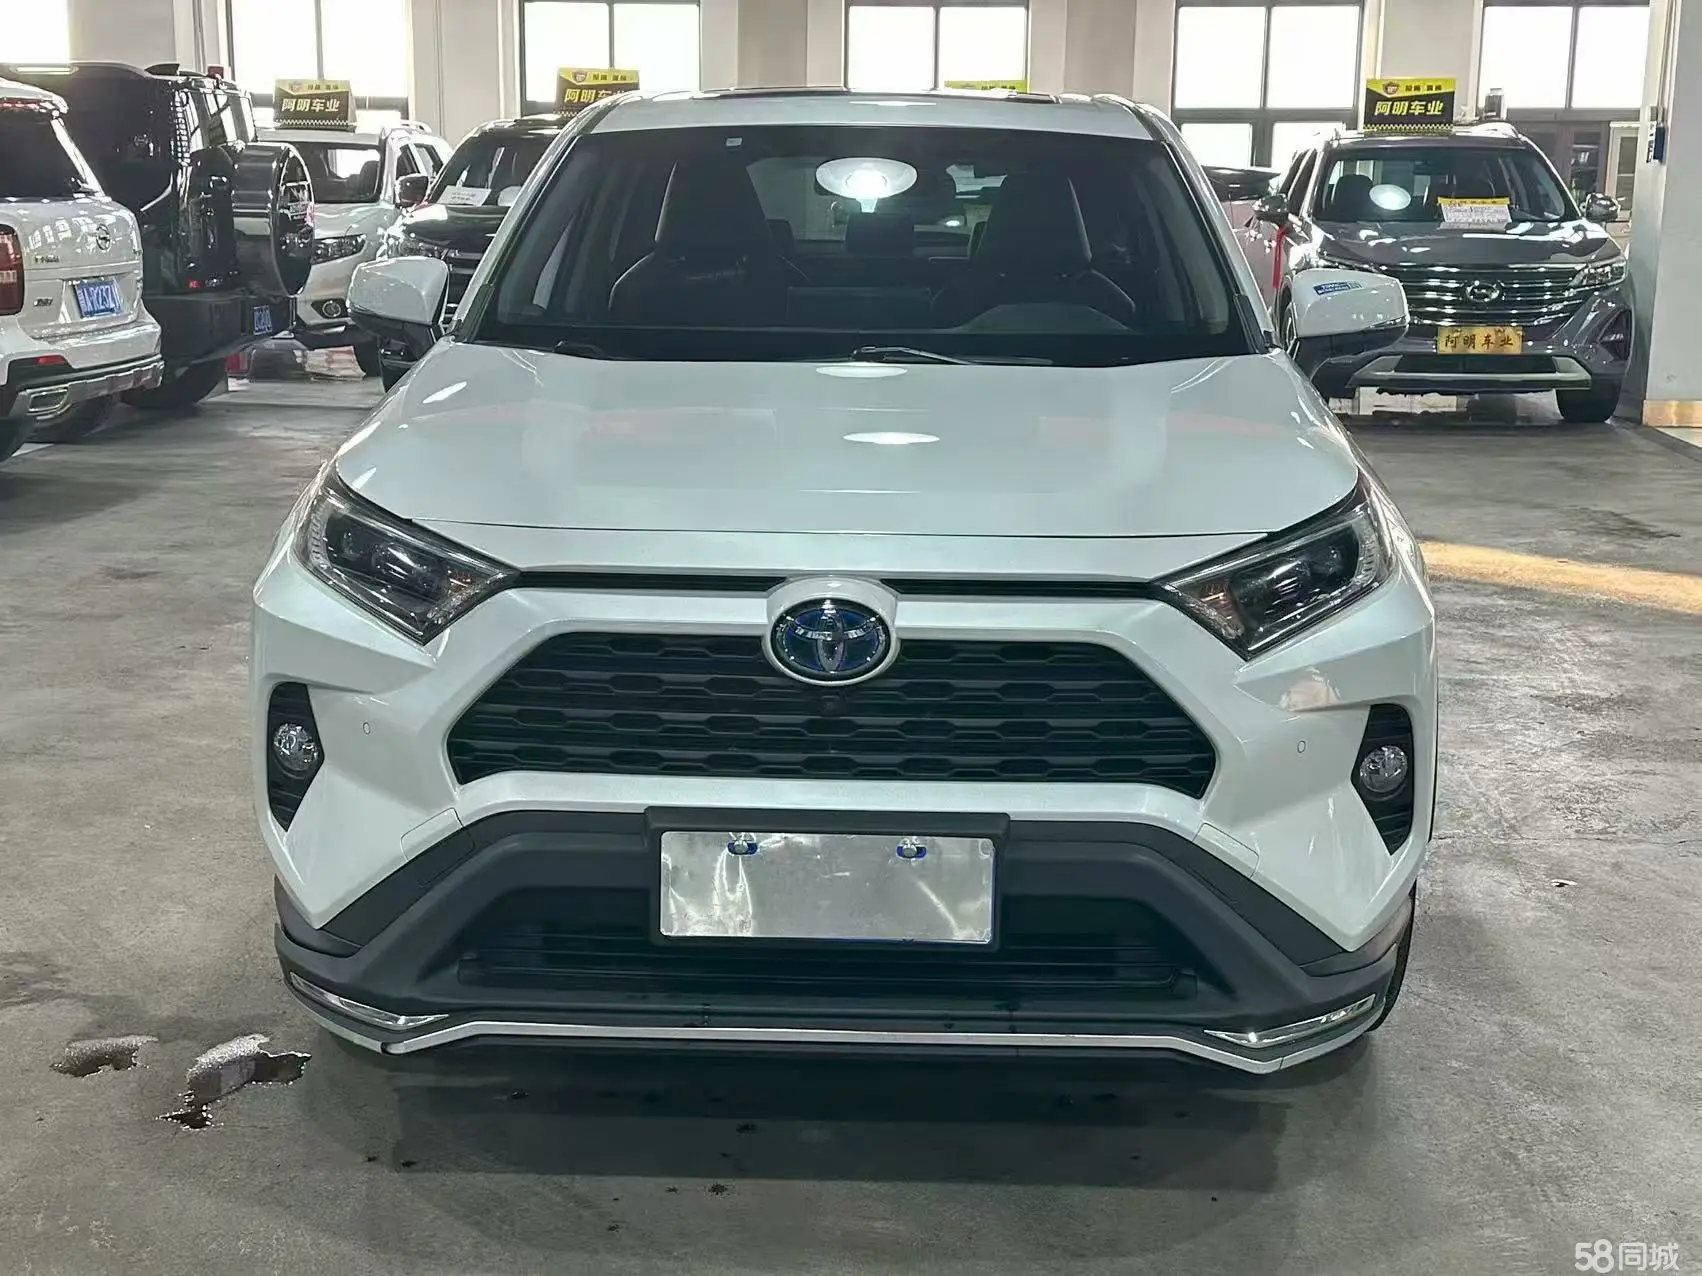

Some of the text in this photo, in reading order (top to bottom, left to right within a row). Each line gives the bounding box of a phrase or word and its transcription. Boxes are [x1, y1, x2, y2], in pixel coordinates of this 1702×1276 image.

[281, 98, 340, 112] 阿明车业
[1374, 100, 1444, 116] 阿明车业
[1445, 333, 1514, 350] 阿明车业
